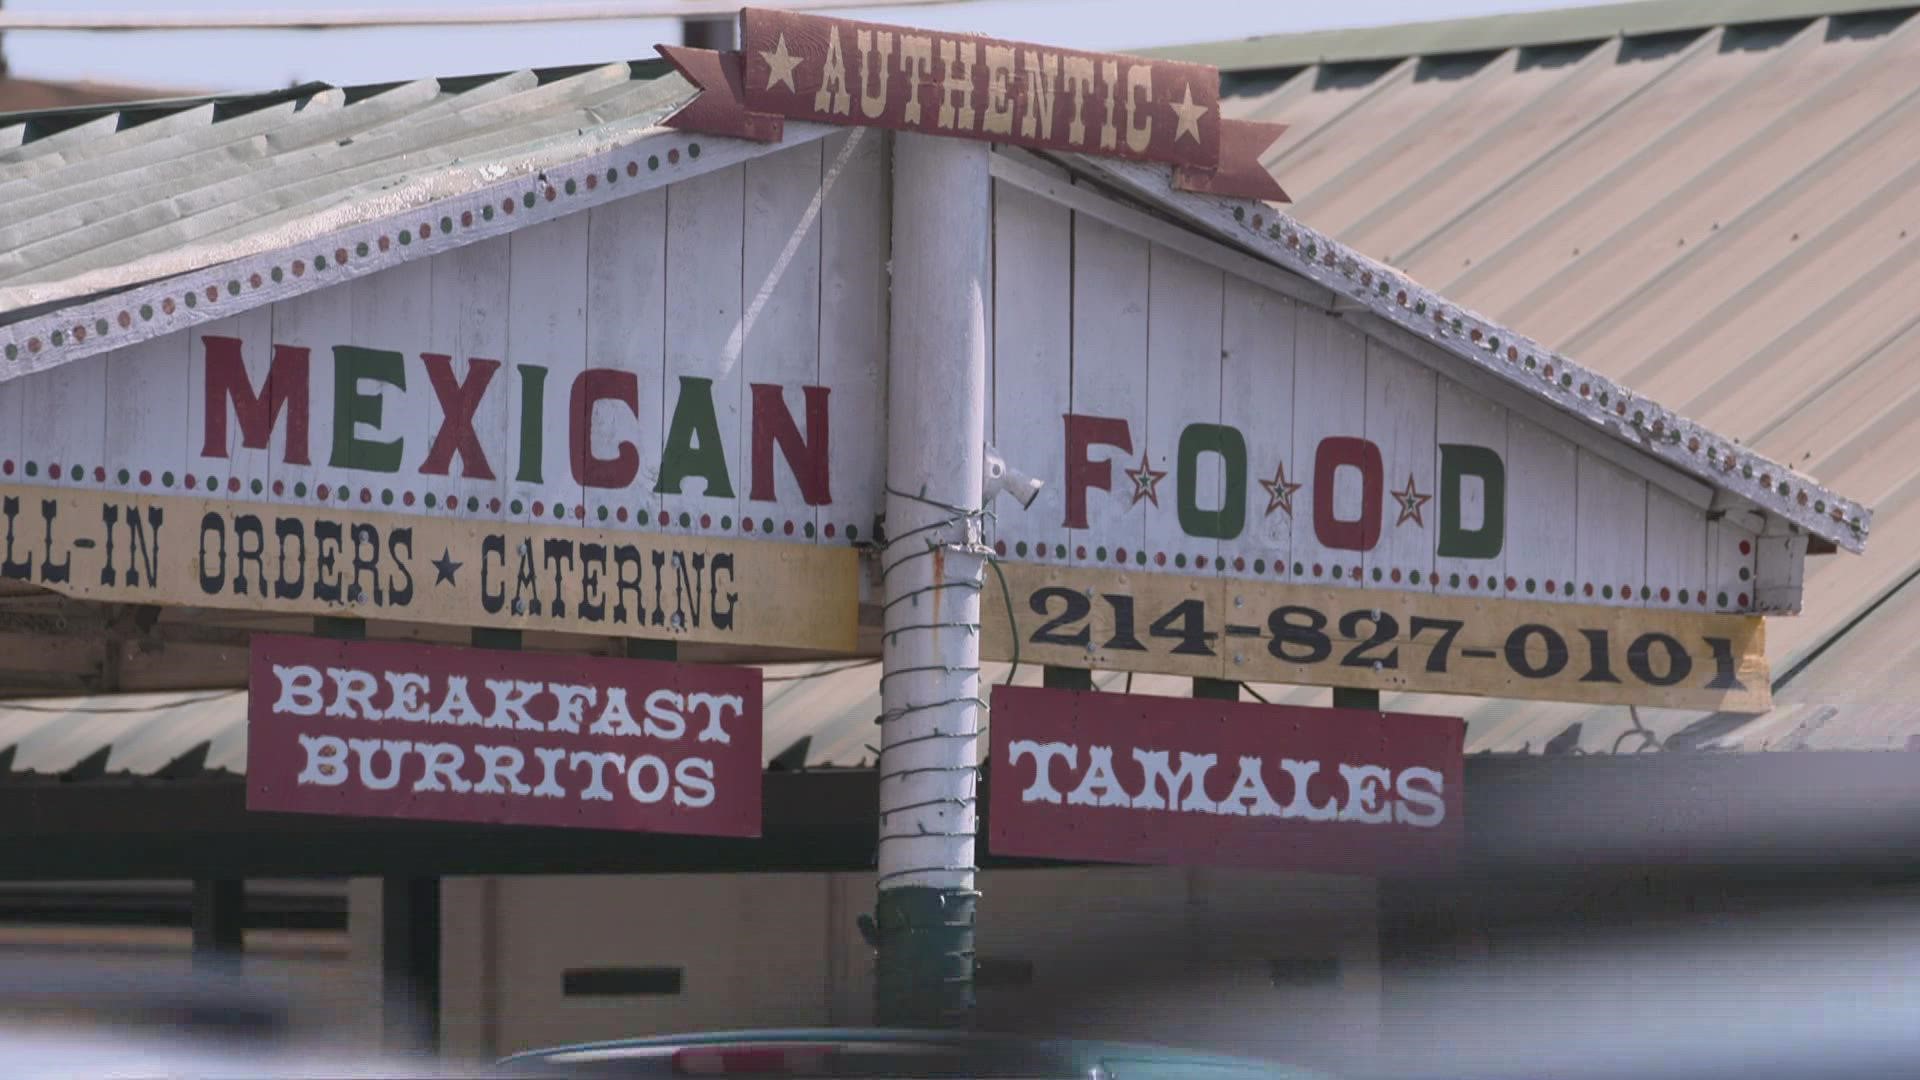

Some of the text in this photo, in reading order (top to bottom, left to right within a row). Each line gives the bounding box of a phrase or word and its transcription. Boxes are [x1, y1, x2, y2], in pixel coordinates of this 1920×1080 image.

[815, 25, 1153, 152] AUTHENTIC
[202, 336, 832, 505] MEXICAN
[2, 496, 738, 630] LL-IN ORDERS CATERING
[1029, 587, 1745, 690] 214-827-0101
[273, 666, 743, 743] BREAKFAST
[298, 734, 717, 807] BURRITOS
[1009, 740, 1446, 827] TAMALES
